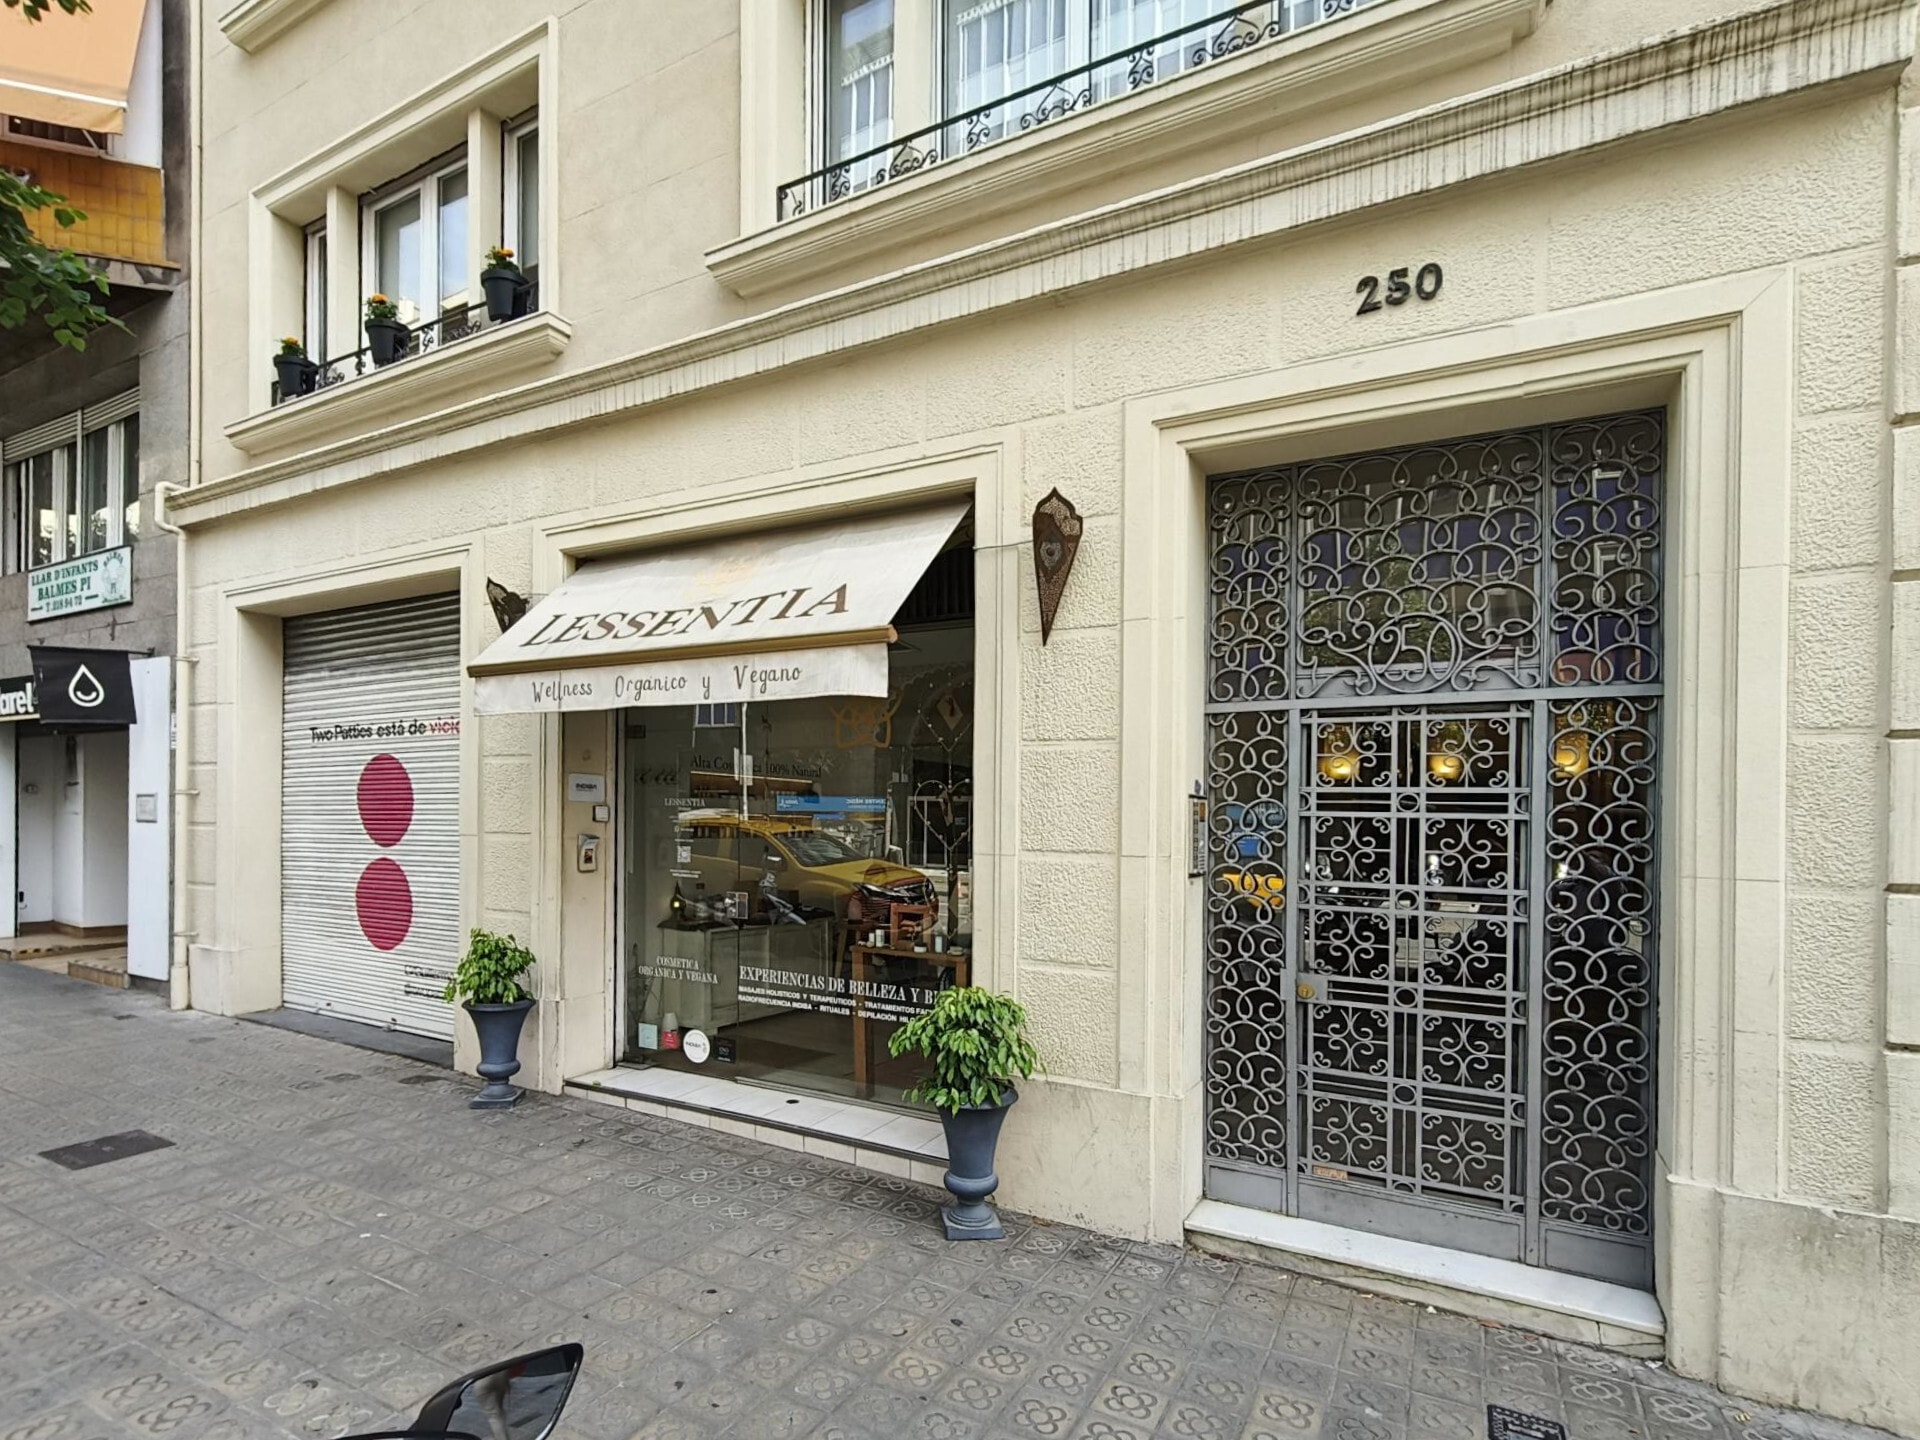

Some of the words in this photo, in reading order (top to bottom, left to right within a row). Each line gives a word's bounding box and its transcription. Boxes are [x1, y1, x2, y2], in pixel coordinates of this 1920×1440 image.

[1355, 262, 1443, 316] 250
[31, 571, 52, 587] LLAR
[37, 580, 77, 601] BALMES
[80, 576, 91, 592] PI
[519, 583, 849, 647] LESSENTIA
[532, 680, 593, 704] Wellness
[702, 676, 711, 701] y
[733, 665, 803, 694] Vegano
[310, 726, 333, 743] Two
[376, 719, 405, 738] está
[407, 718, 427, 735] de
[690, 754, 711, 769] Alta
[792, 763, 822, 778] Natural
[678, 969, 684, 980] Y
[685, 970, 719, 985] VEGANA
[739, 965, 825, 990] EXPERIENCIAS
[828, 977, 846, 993] DE
[849, 979, 906, 1002] BELLEZA
[910, 987, 920, 1003] Y
[737, 994, 791, 1007] RADIOFRECUENCIA
[819, 1004, 850, 1016] RITUALES
[738, 985, 765, 995] MASAJES
[864, 1001, 915, 1014] TRATAMIENTOS
